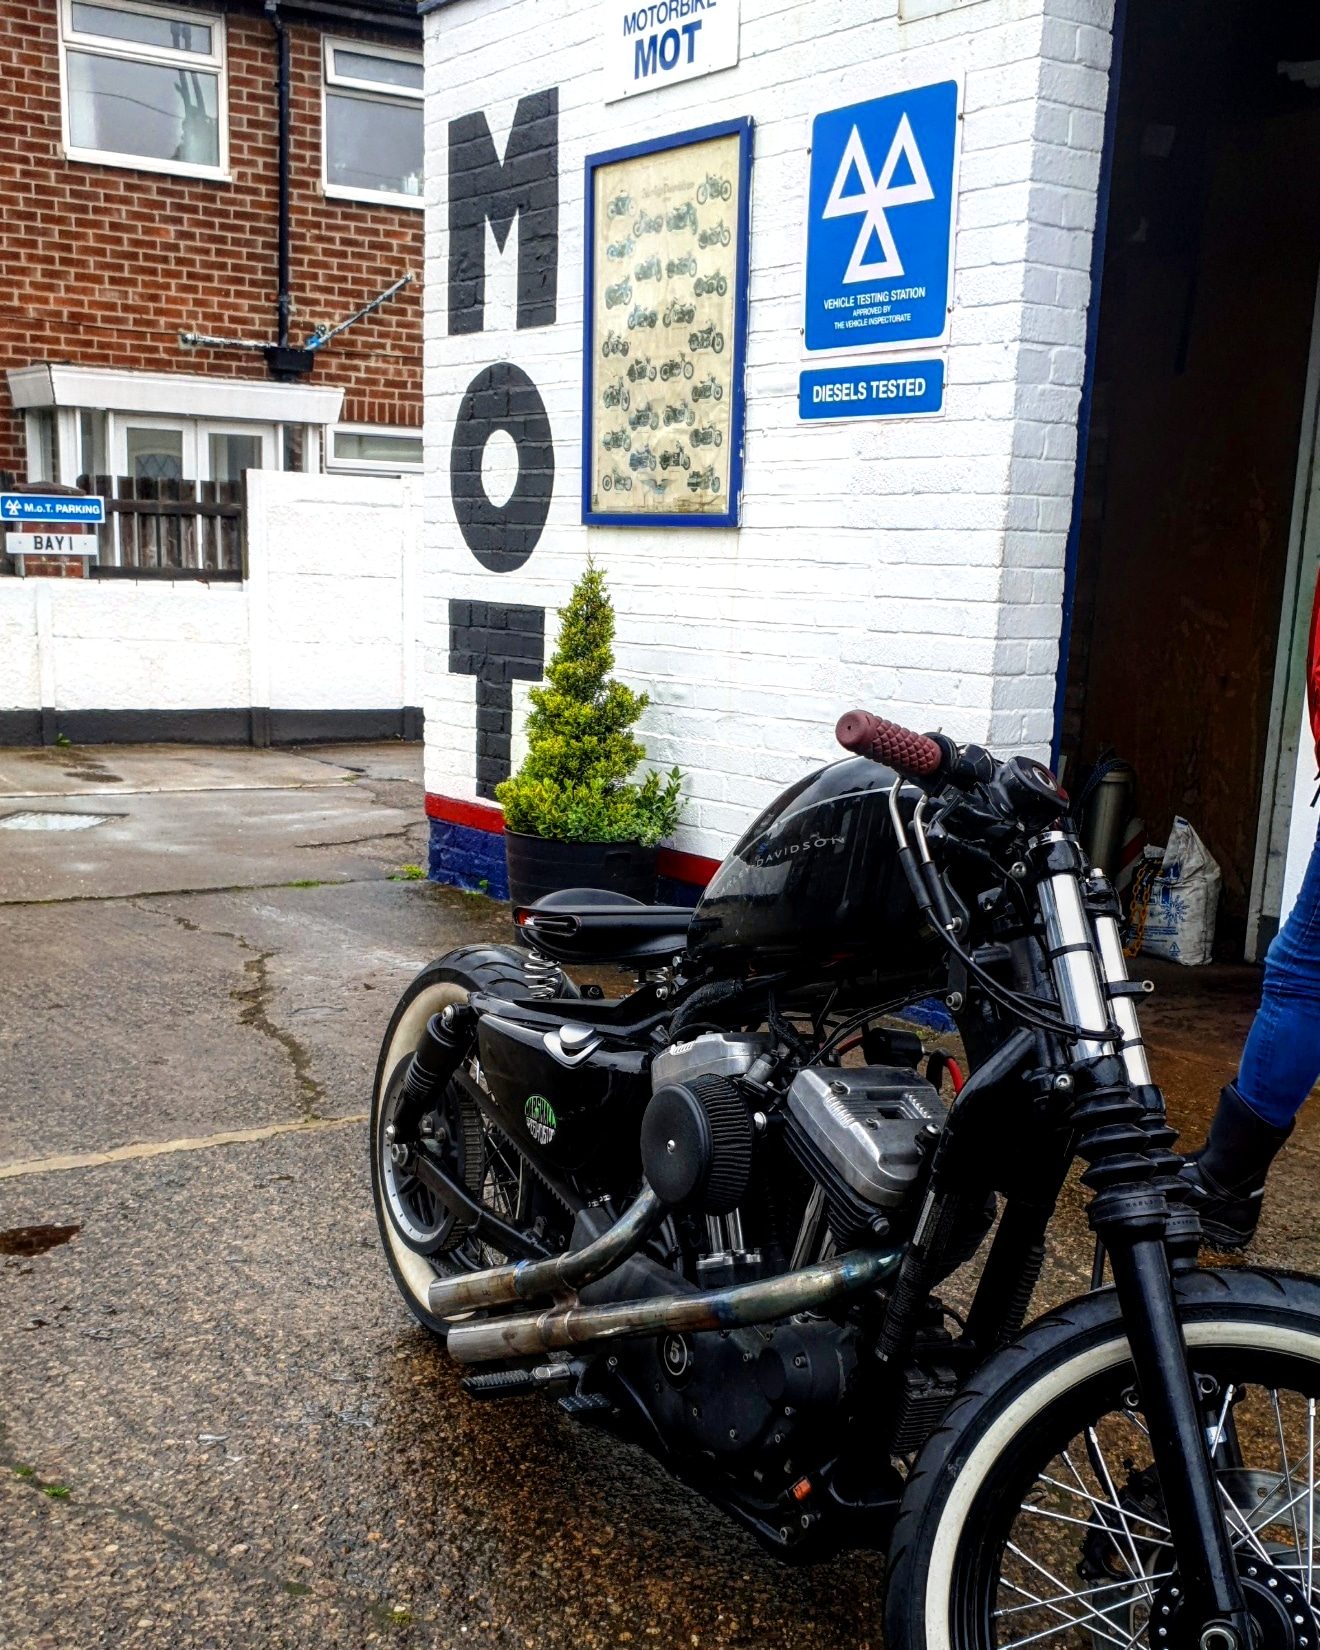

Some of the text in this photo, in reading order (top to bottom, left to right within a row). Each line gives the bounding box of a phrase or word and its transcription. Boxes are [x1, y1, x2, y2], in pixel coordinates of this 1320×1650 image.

[634, 19, 702, 80] MOT
[824, 287, 926, 310] VEHICLE TESTING STATION
[853, 305, 891, 317] APPROVED BY
[834, 313, 912, 330] THE VEHICLE INSPECTORATE
[813, 377, 926, 403] DIESELS TESTED
[448, 86, 558, 798] MOT
[24, 503, 100, 514] M.o.T. PARKING
[34, 536, 64, 551] BAY
